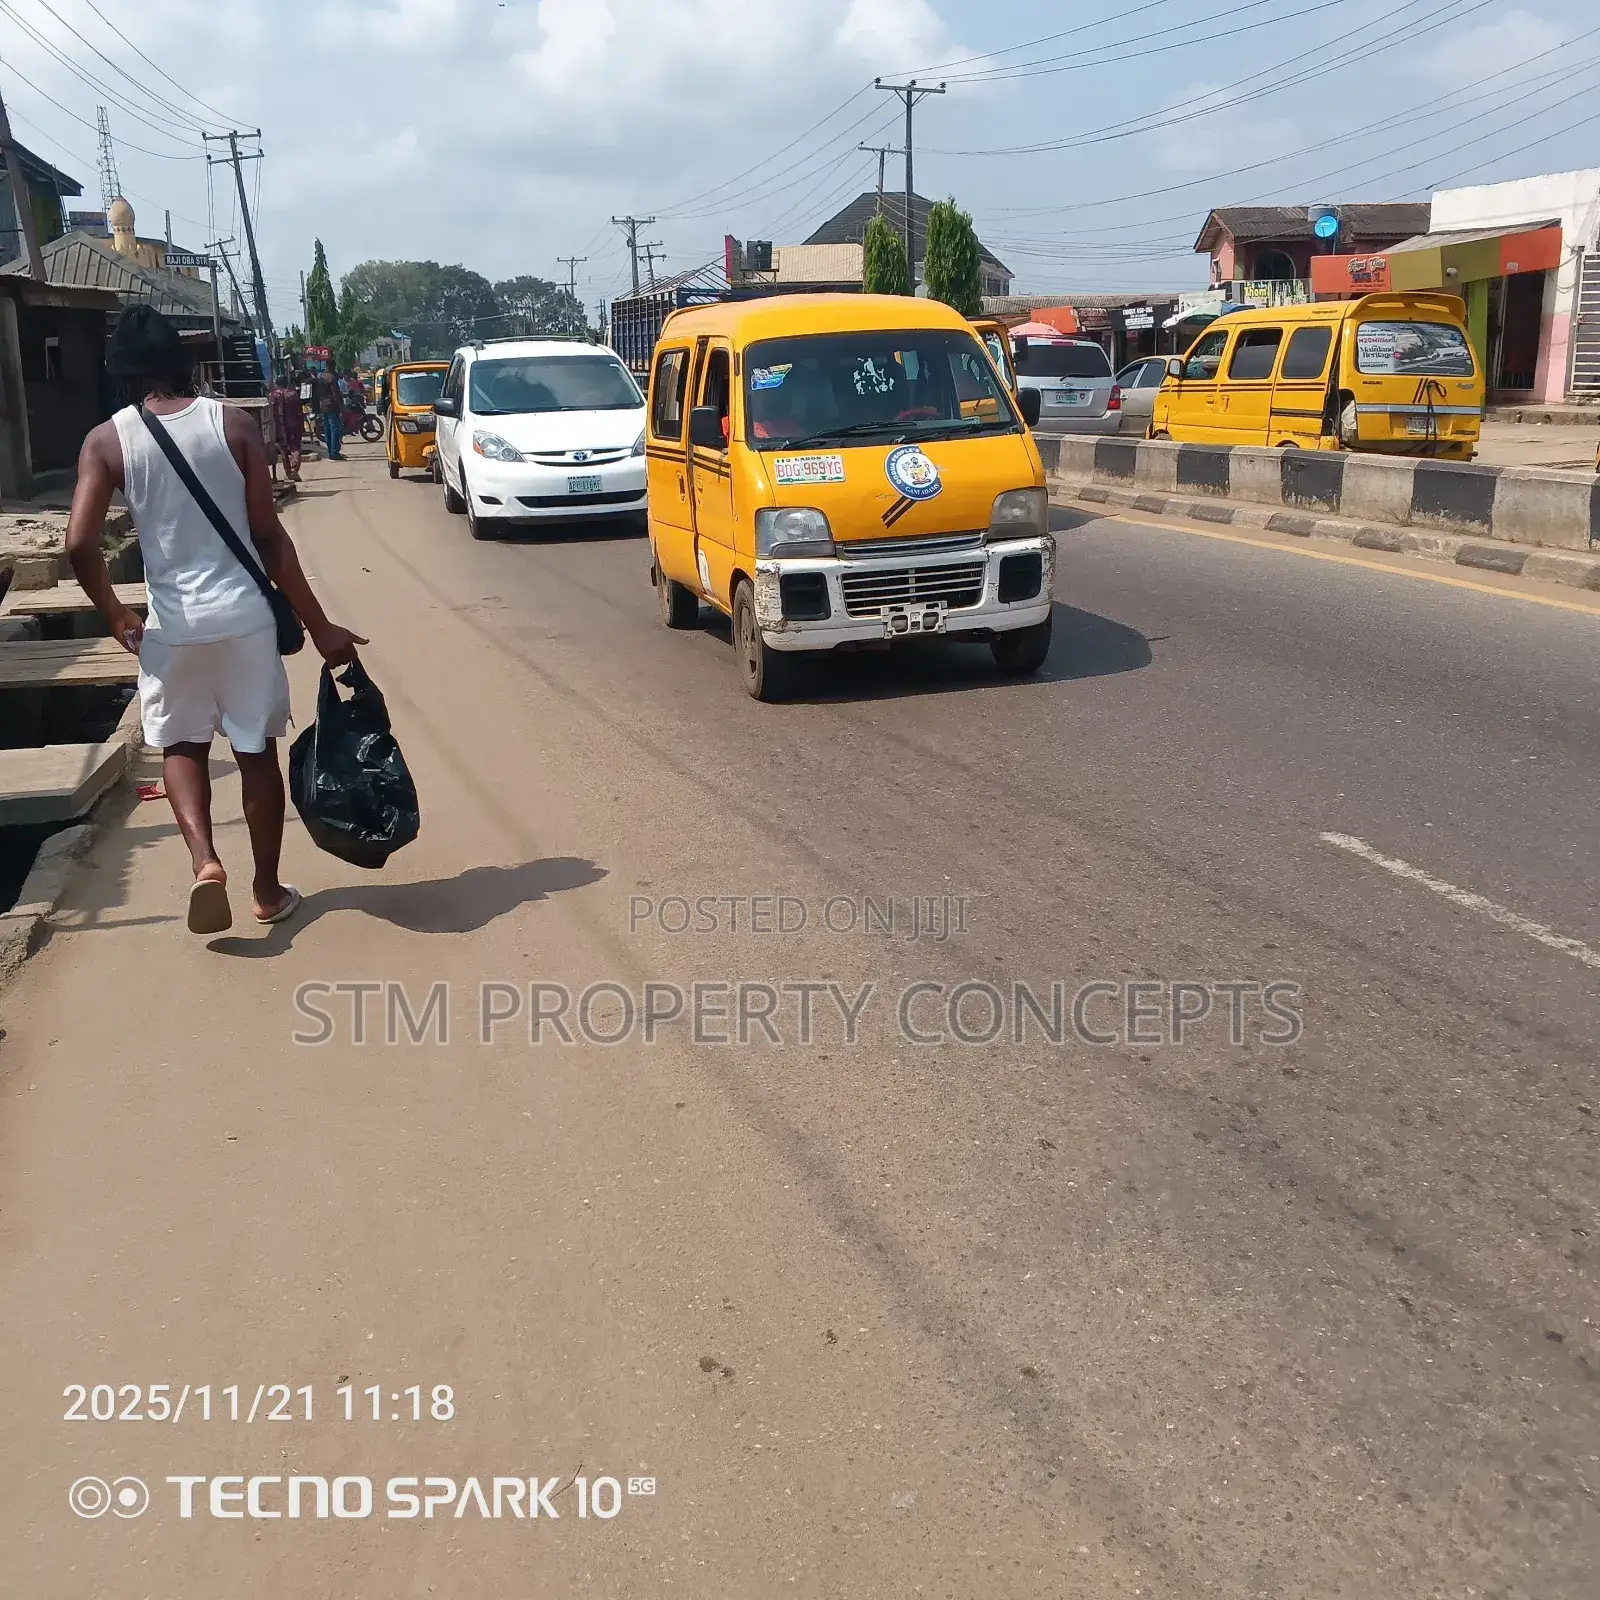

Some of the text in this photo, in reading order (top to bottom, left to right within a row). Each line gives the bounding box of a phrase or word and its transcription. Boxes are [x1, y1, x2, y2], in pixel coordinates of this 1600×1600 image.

[166, 256, 208, 265] RAJI OBA STR
